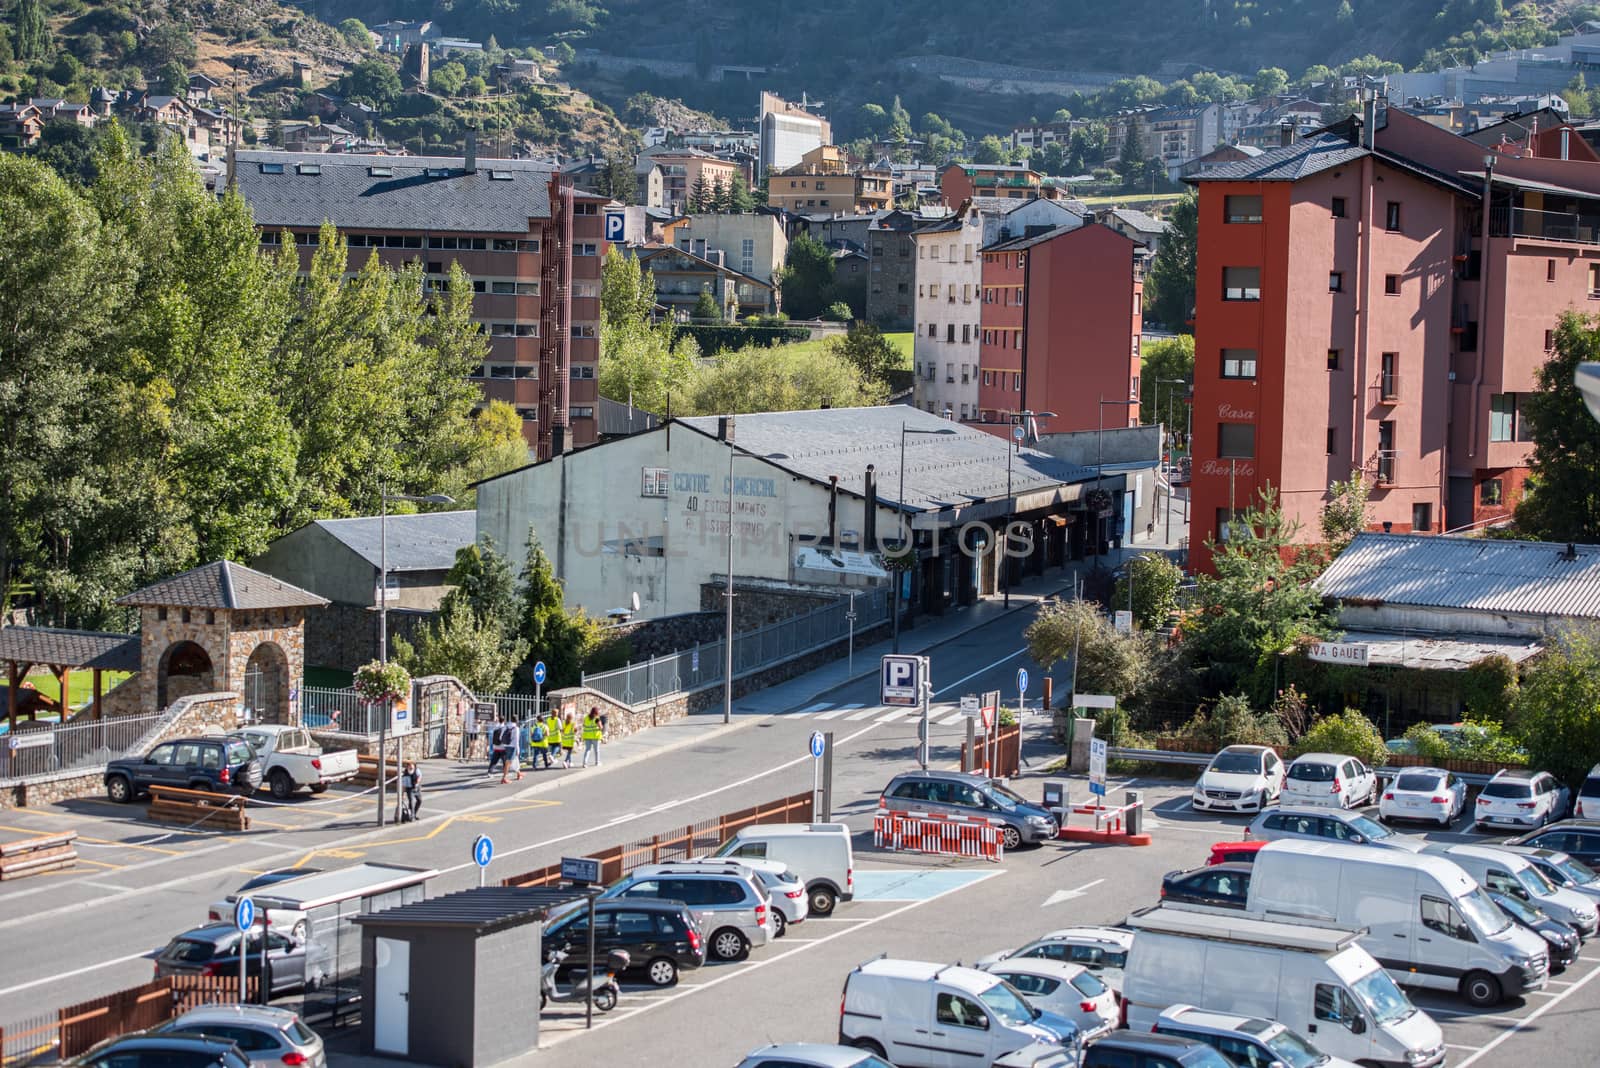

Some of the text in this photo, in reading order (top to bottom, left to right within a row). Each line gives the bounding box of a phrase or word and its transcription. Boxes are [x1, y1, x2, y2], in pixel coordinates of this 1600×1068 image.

[608, 215, 623, 239] P
[1218, 404, 1255, 418] Casa
[674, 473, 711, 493] CENTRE
[890, 662, 910, 687] P
